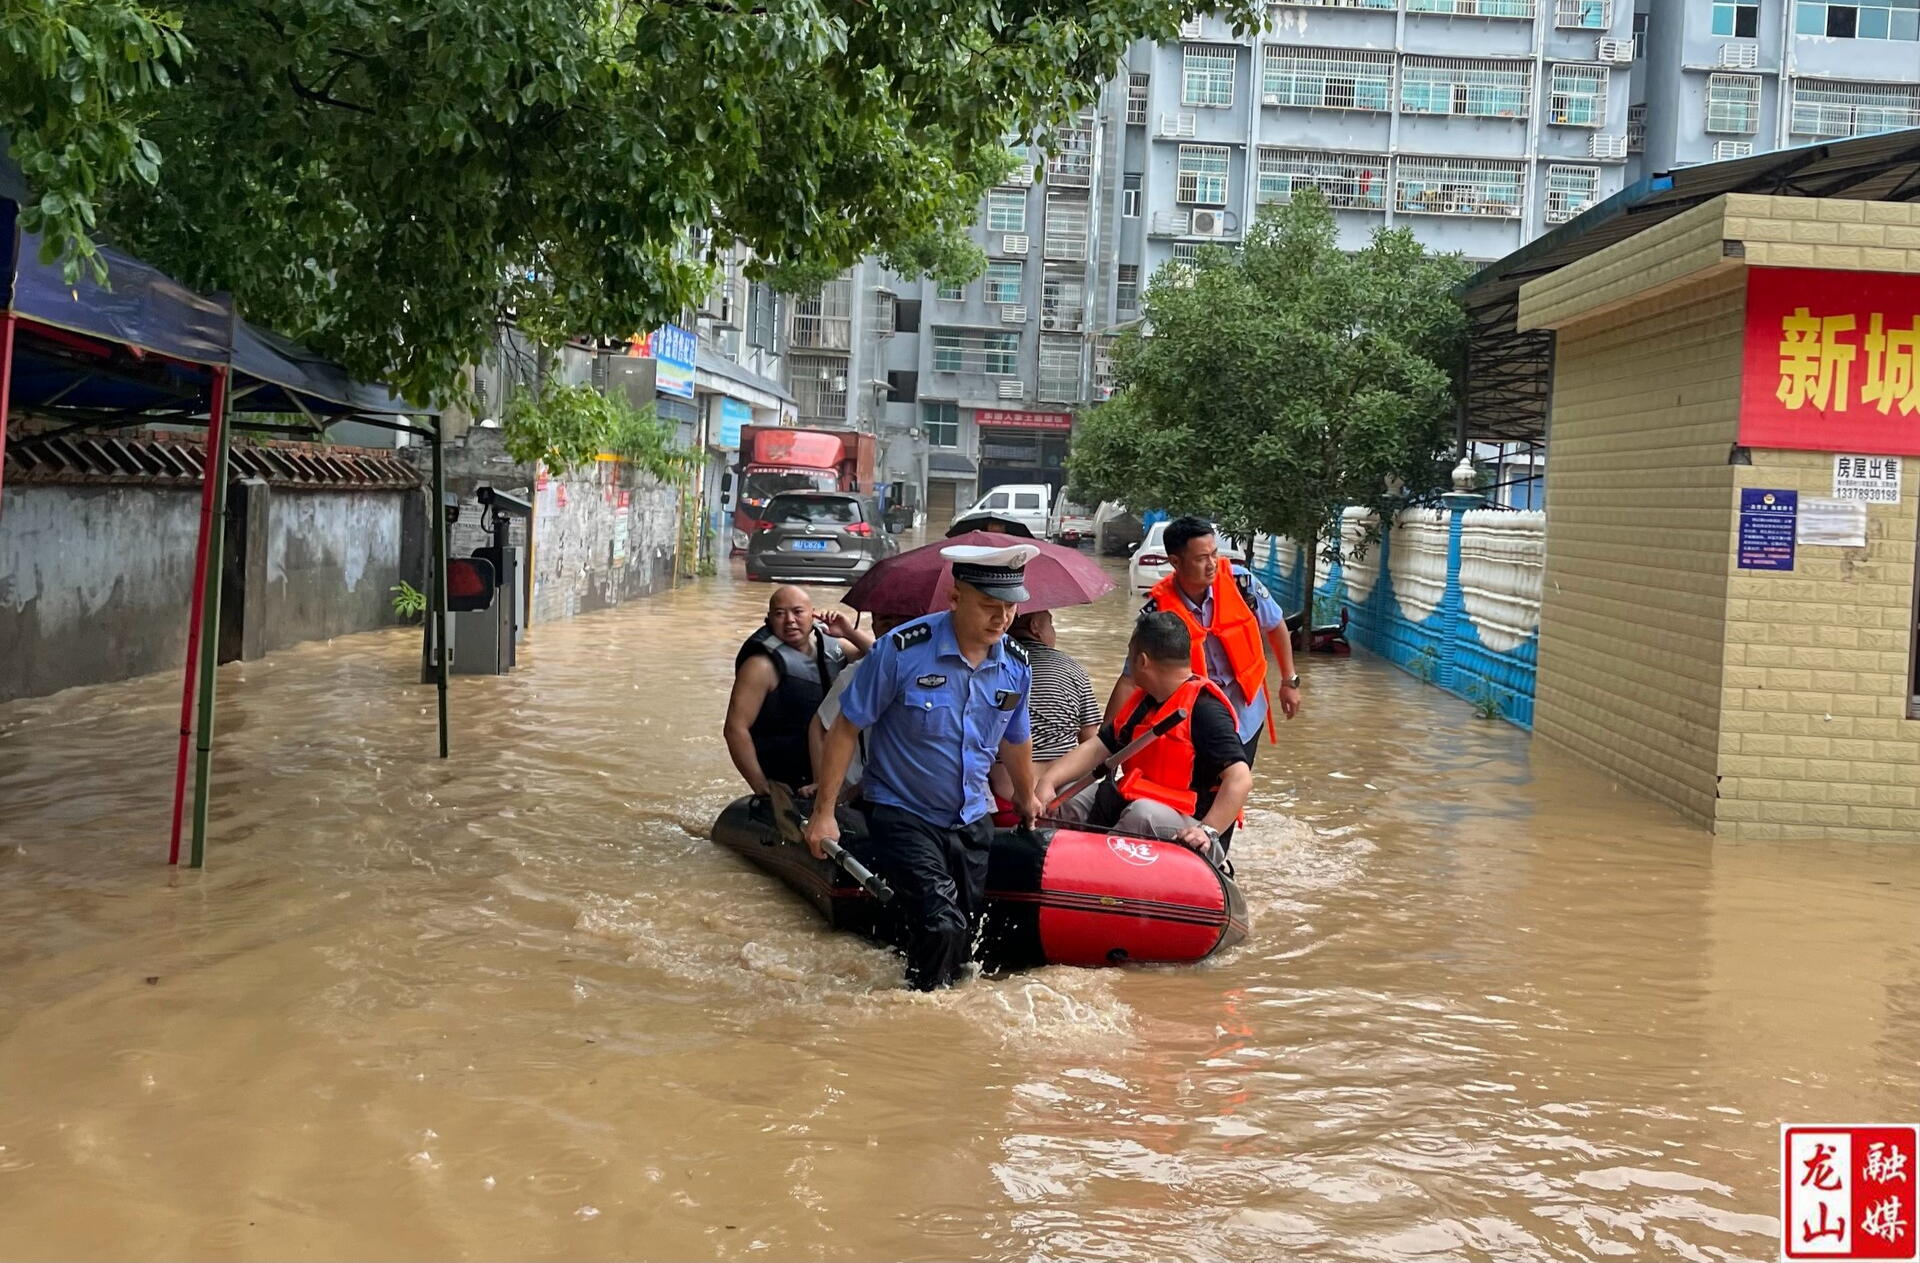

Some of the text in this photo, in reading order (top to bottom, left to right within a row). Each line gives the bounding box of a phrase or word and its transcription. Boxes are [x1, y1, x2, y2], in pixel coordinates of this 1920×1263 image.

[1776, 307, 1920, 416] 新城
[1838, 457, 1897, 480] 房屋出售
[1837, 488, 1897, 501] 13378930198
